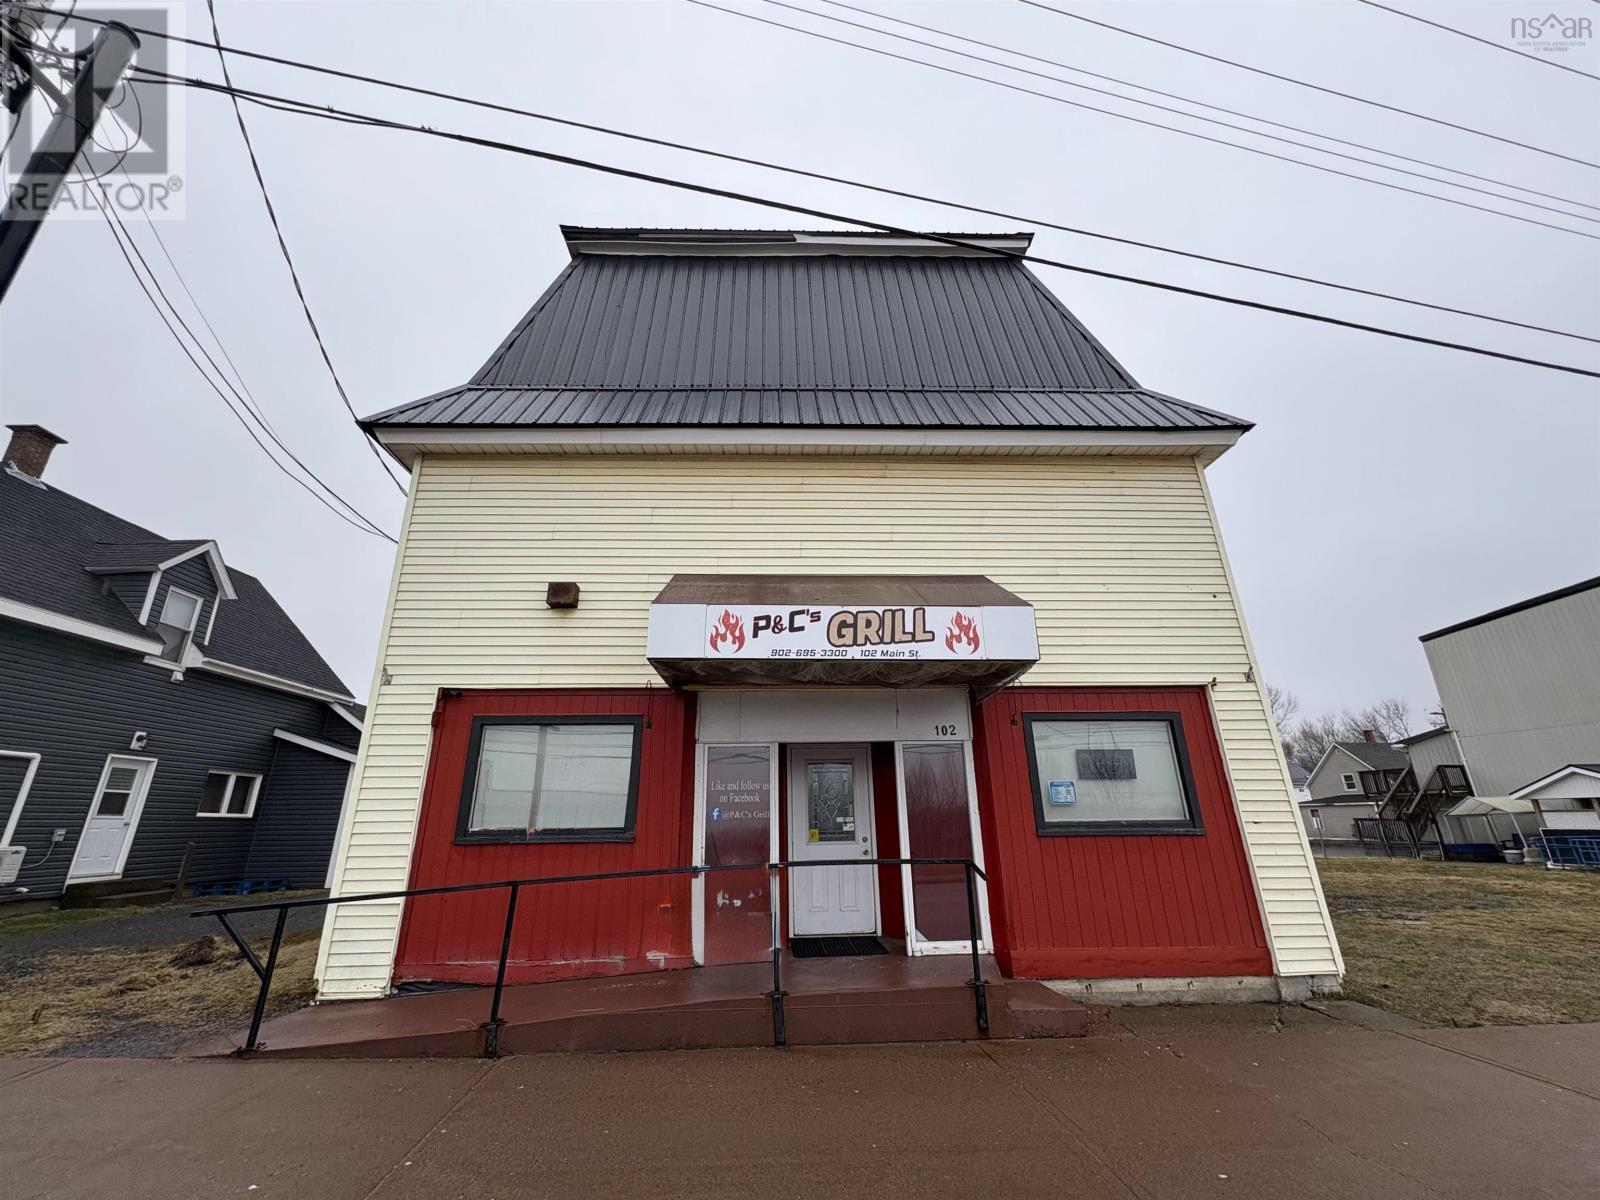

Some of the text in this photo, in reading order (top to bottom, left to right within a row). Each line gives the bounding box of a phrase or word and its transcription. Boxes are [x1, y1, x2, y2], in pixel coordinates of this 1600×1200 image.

[752, 607, 936, 648] P&C's GRILL
[770, 649, 921, 659] 902-695-3300 102 Main St.
[934, 724, 957, 736] 102
[711, 780, 726, 791] Like
[727, 780, 739, 790] and
[741, 780, 760, 791] follow
[720, 792, 761, 803] on Facebook
[753, 810, 770, 818] Grill
